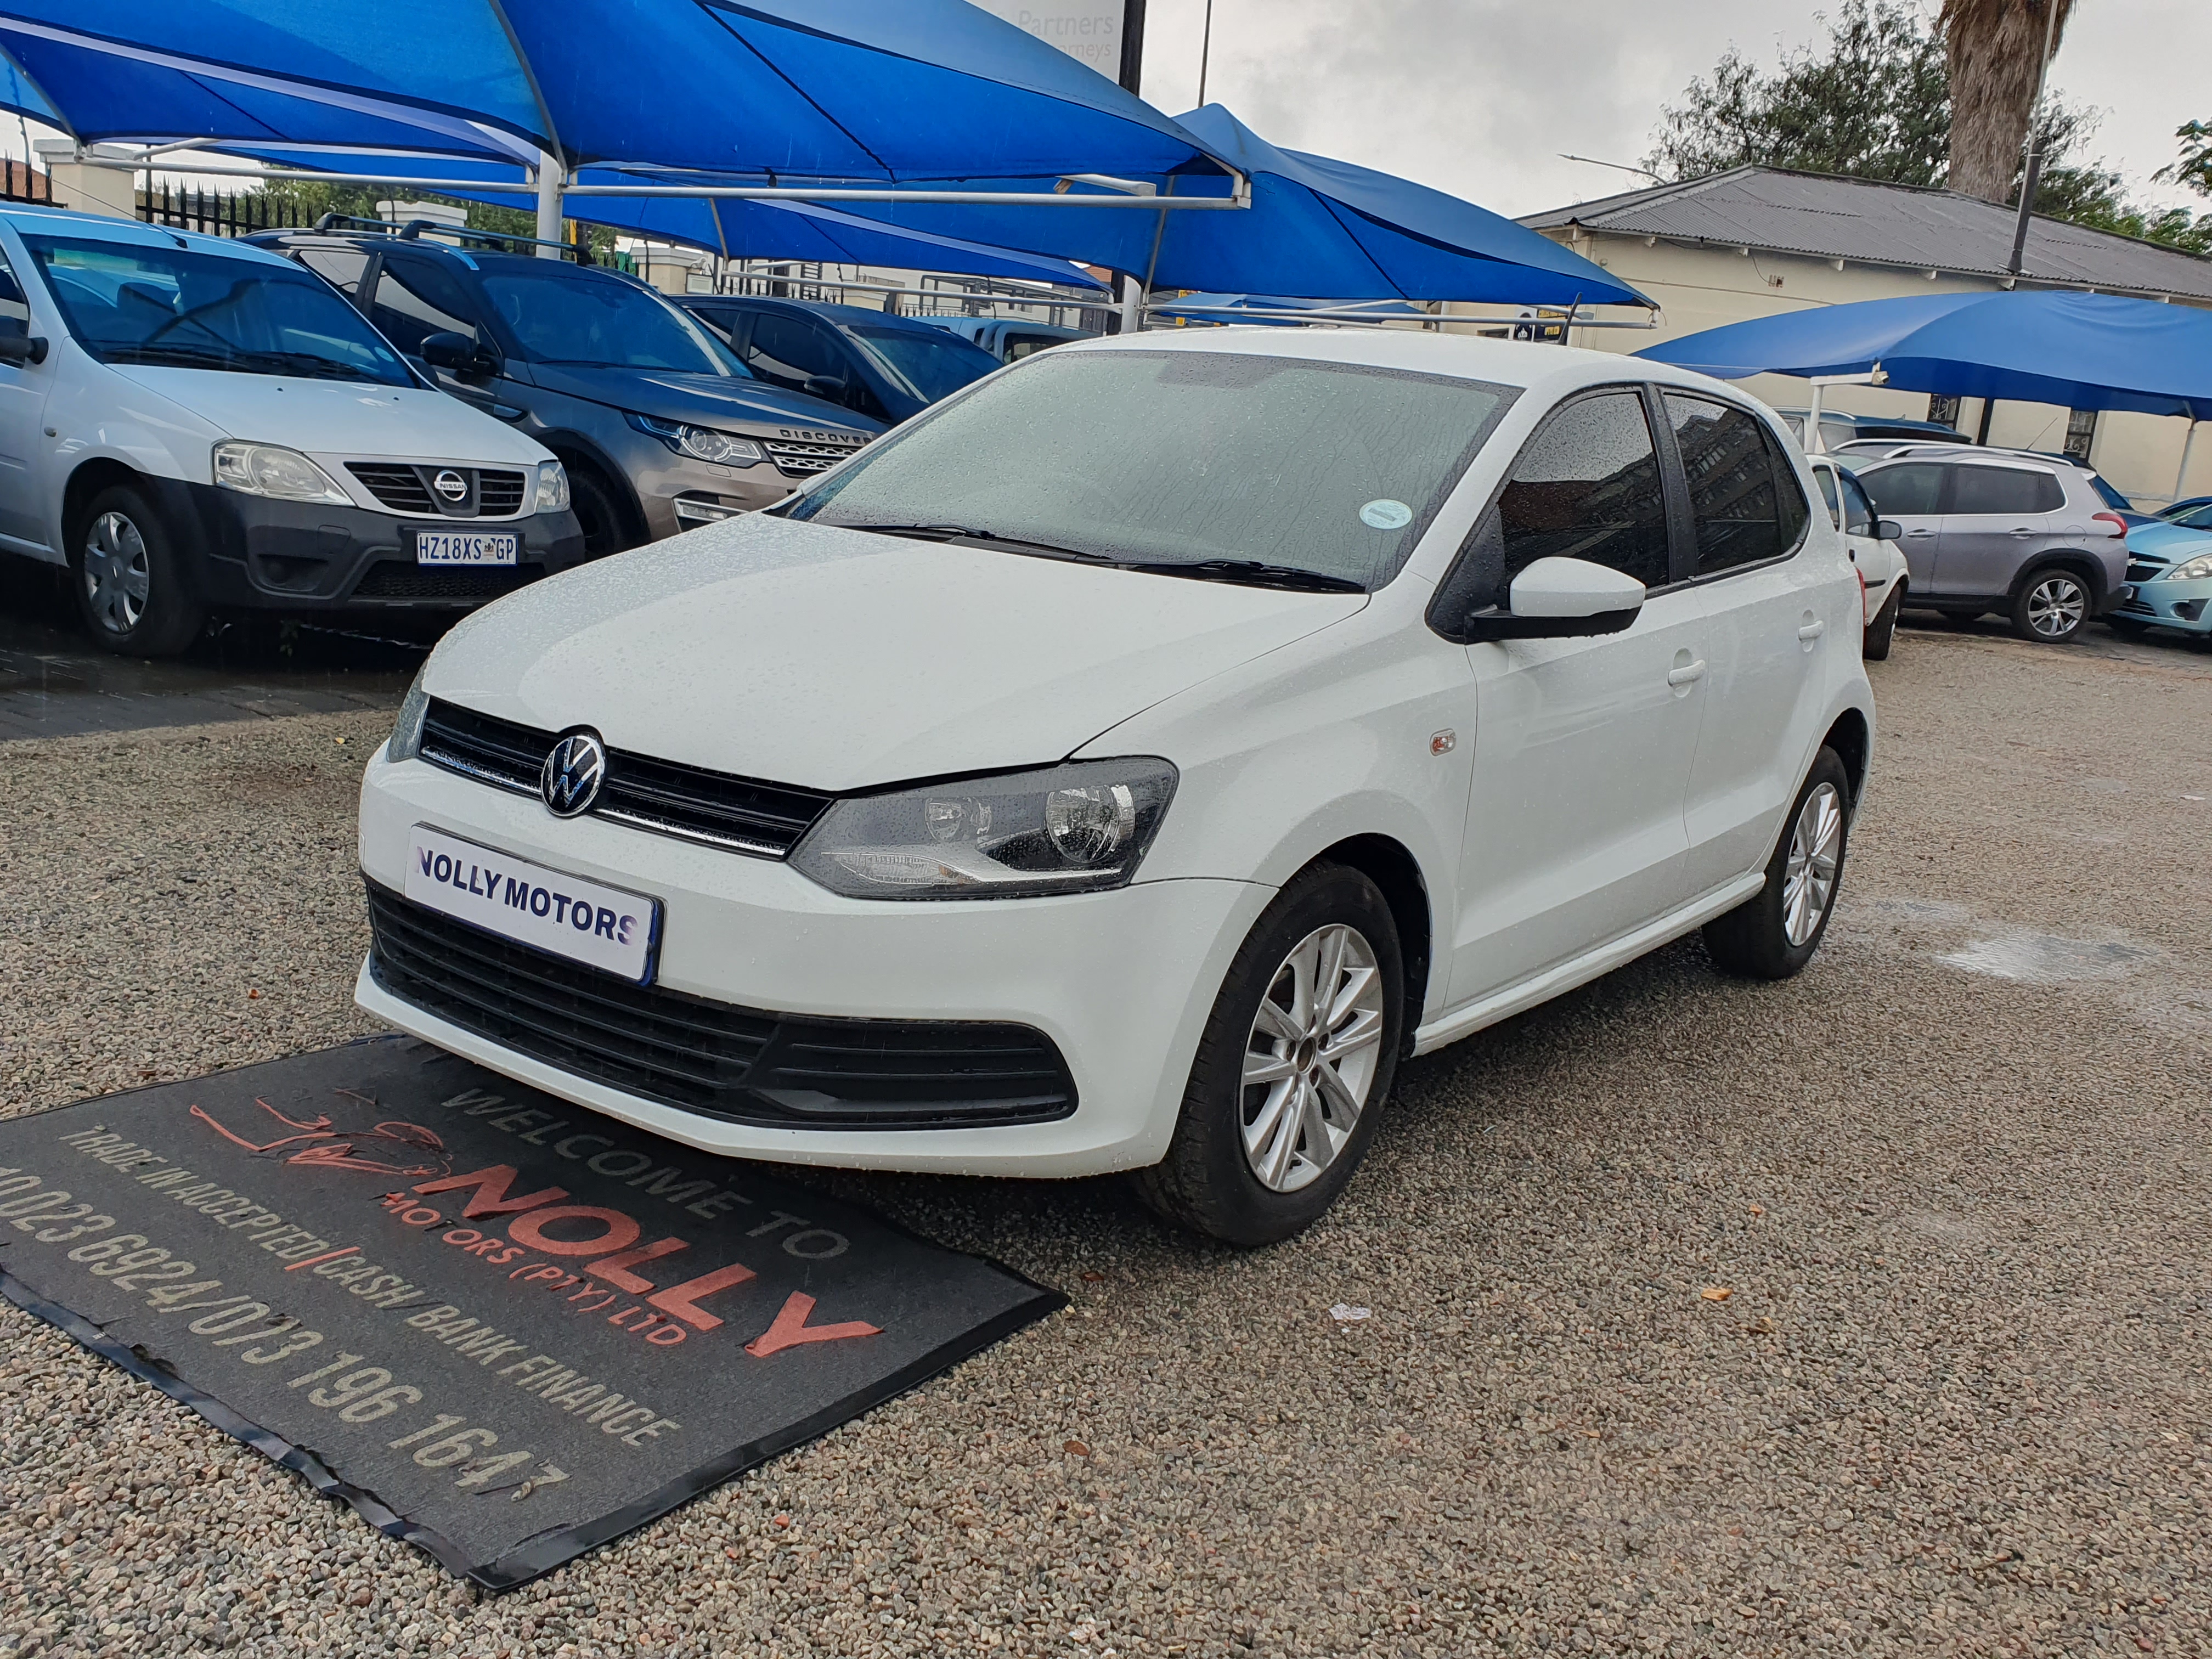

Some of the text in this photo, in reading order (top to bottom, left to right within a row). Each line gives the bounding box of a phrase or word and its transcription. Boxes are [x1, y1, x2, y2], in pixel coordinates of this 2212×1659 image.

[1018, 10, 1114, 36] Partners
[419, 537, 514, 560] HZ18XS GP
[415, 845, 638, 946] NOLLY MOTORS
[441, 1088, 850, 1259] WELCOME TO
[59, 1124, 168, 1173] TRADE
[135, 1167, 200, 1189] IN
[496, 1353, 682, 1447] FINANCE
[380, 1192, 686, 1345] MOORS (PTY) LTD
[411, 1164, 884, 1357] NOLLY
[286, 1351, 423, 1423] 196
[385, 1413, 572, 1502] 1647
